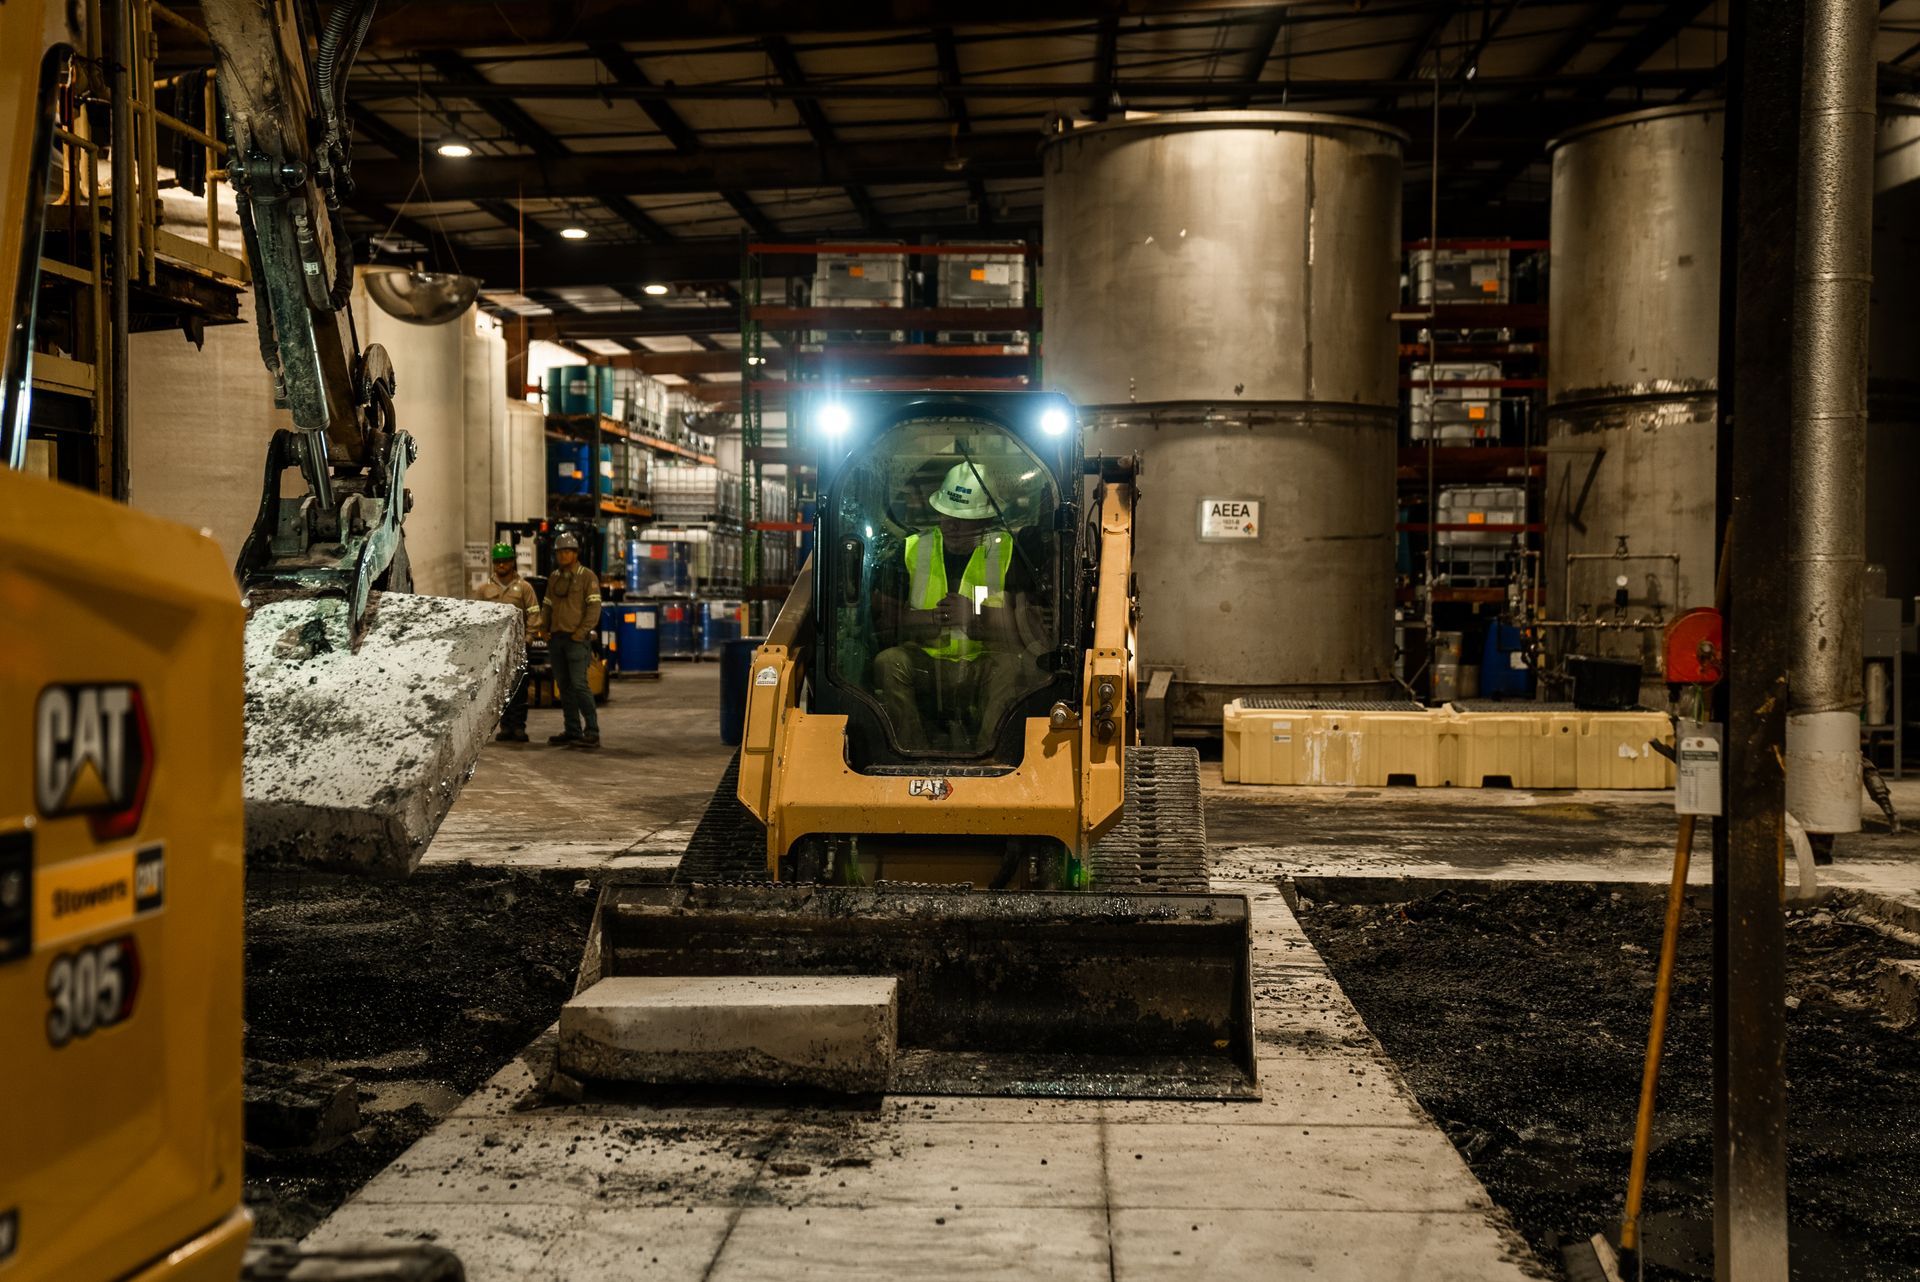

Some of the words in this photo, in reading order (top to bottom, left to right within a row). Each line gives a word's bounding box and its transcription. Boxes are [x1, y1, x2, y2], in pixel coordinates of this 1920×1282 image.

[1211, 503, 1250, 517] AEEA
[38, 686, 132, 812] CAT
[910, 779, 943, 796] CAT
[52, 879, 128, 918] Stowers
[48, 944, 122, 1042] 305
